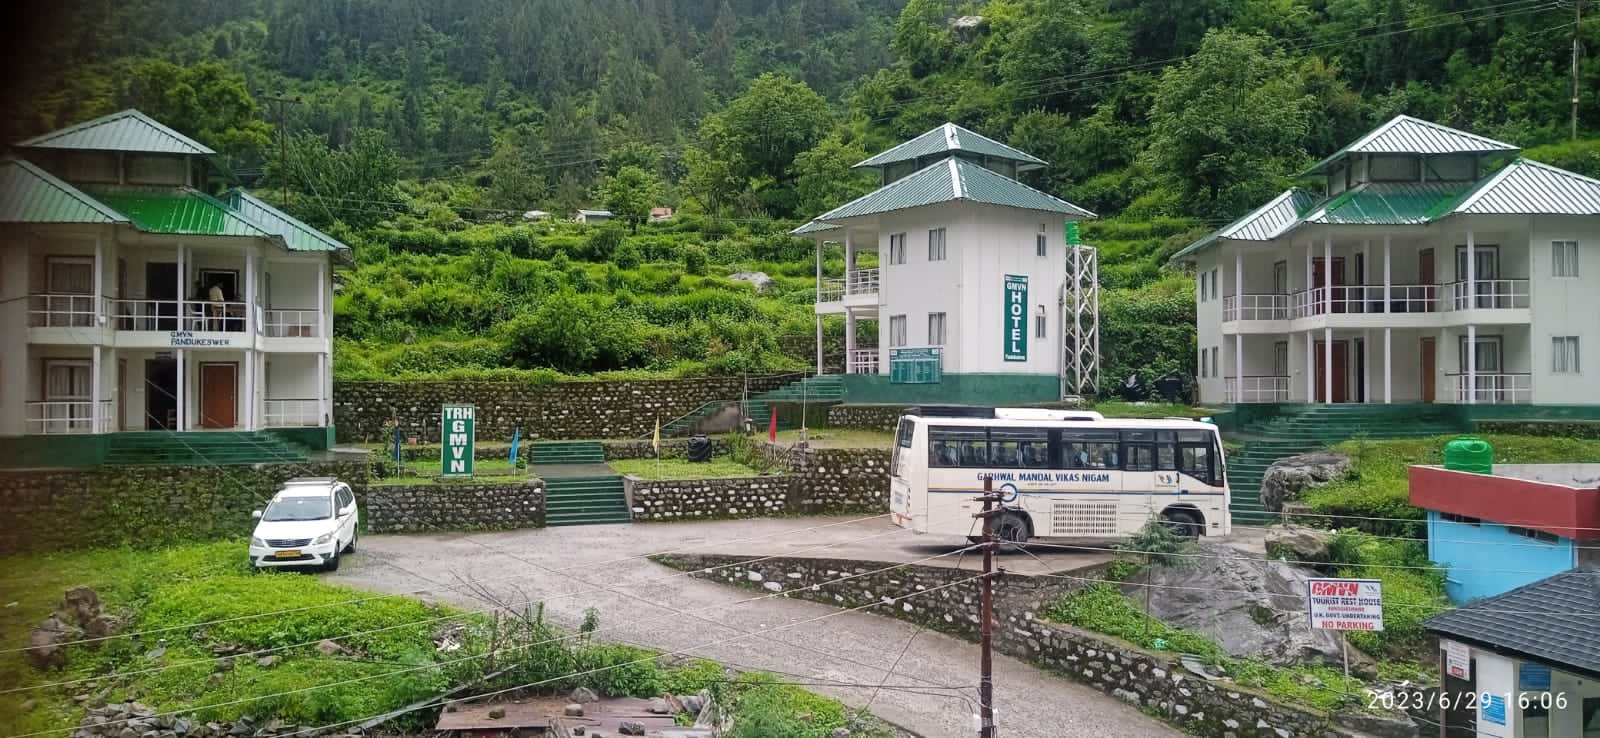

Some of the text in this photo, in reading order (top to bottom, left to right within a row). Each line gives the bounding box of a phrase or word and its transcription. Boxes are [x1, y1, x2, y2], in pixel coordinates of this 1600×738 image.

[1011, 291, 1022, 353] HOTEL
[445, 407, 473, 420] TRH
[449, 420, 468, 473] GMVN
[1019, 473, 1053, 482] MANDAL
[1055, 473, 1080, 482] VIKAS
[1081, 473, 1110, 483] NIGAM
[1312, 582, 1359, 596] GMVN
[1341, 597, 1357, 606] REST
[1358, 598, 1381, 606] HOUSE
[1322, 621, 1374, 630] NO PARKING
